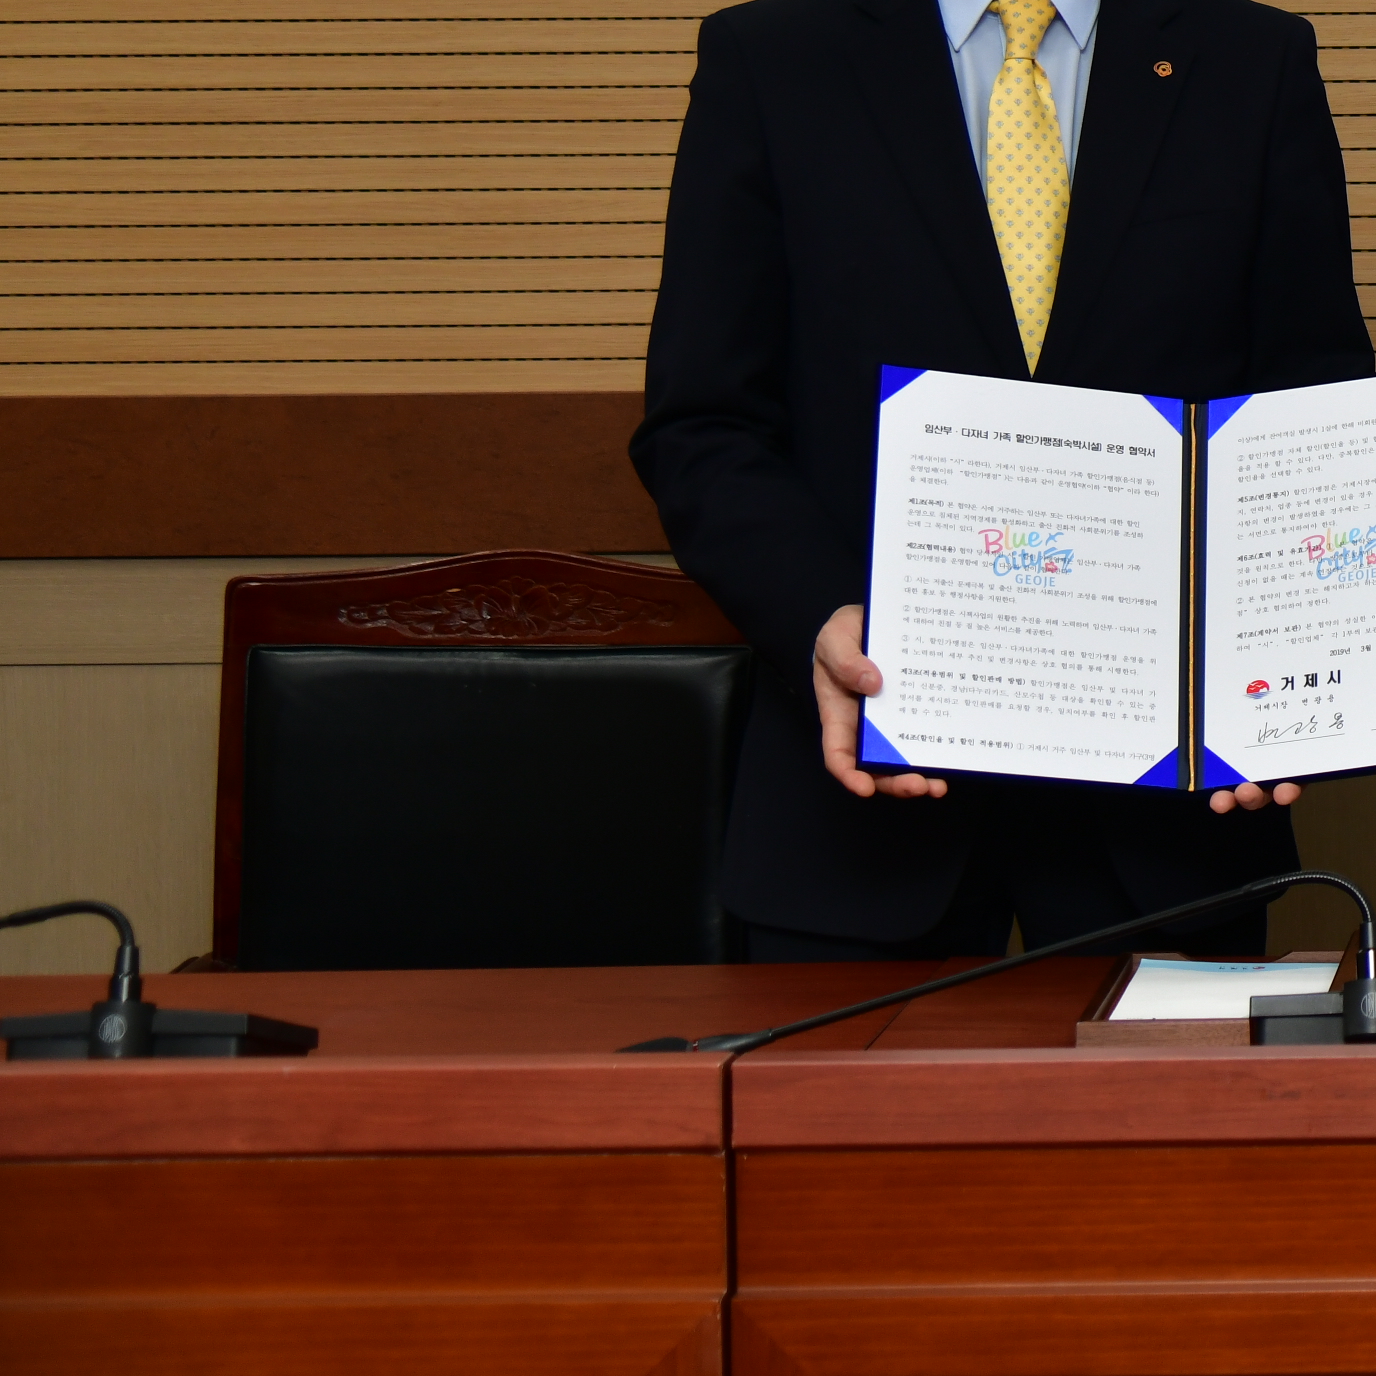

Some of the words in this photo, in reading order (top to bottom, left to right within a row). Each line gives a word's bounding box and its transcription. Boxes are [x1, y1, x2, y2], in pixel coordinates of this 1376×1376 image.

[924, 423, 952, 435] 임산부
[961, 427, 988, 439] 다자녀
[993, 431, 1011, 442] 가족
[1106, 443, 1124, 454] 운영
[1128, 445, 1155, 457] 협약서
[978, 525, 1042, 554] Blue
[1301, 527, 1363, 560] Blue
[1015, 574, 1056, 588] GEOJE
[1329, 647, 1350, 656] 2019년
[1360, 643, 1371, 652] 3월
